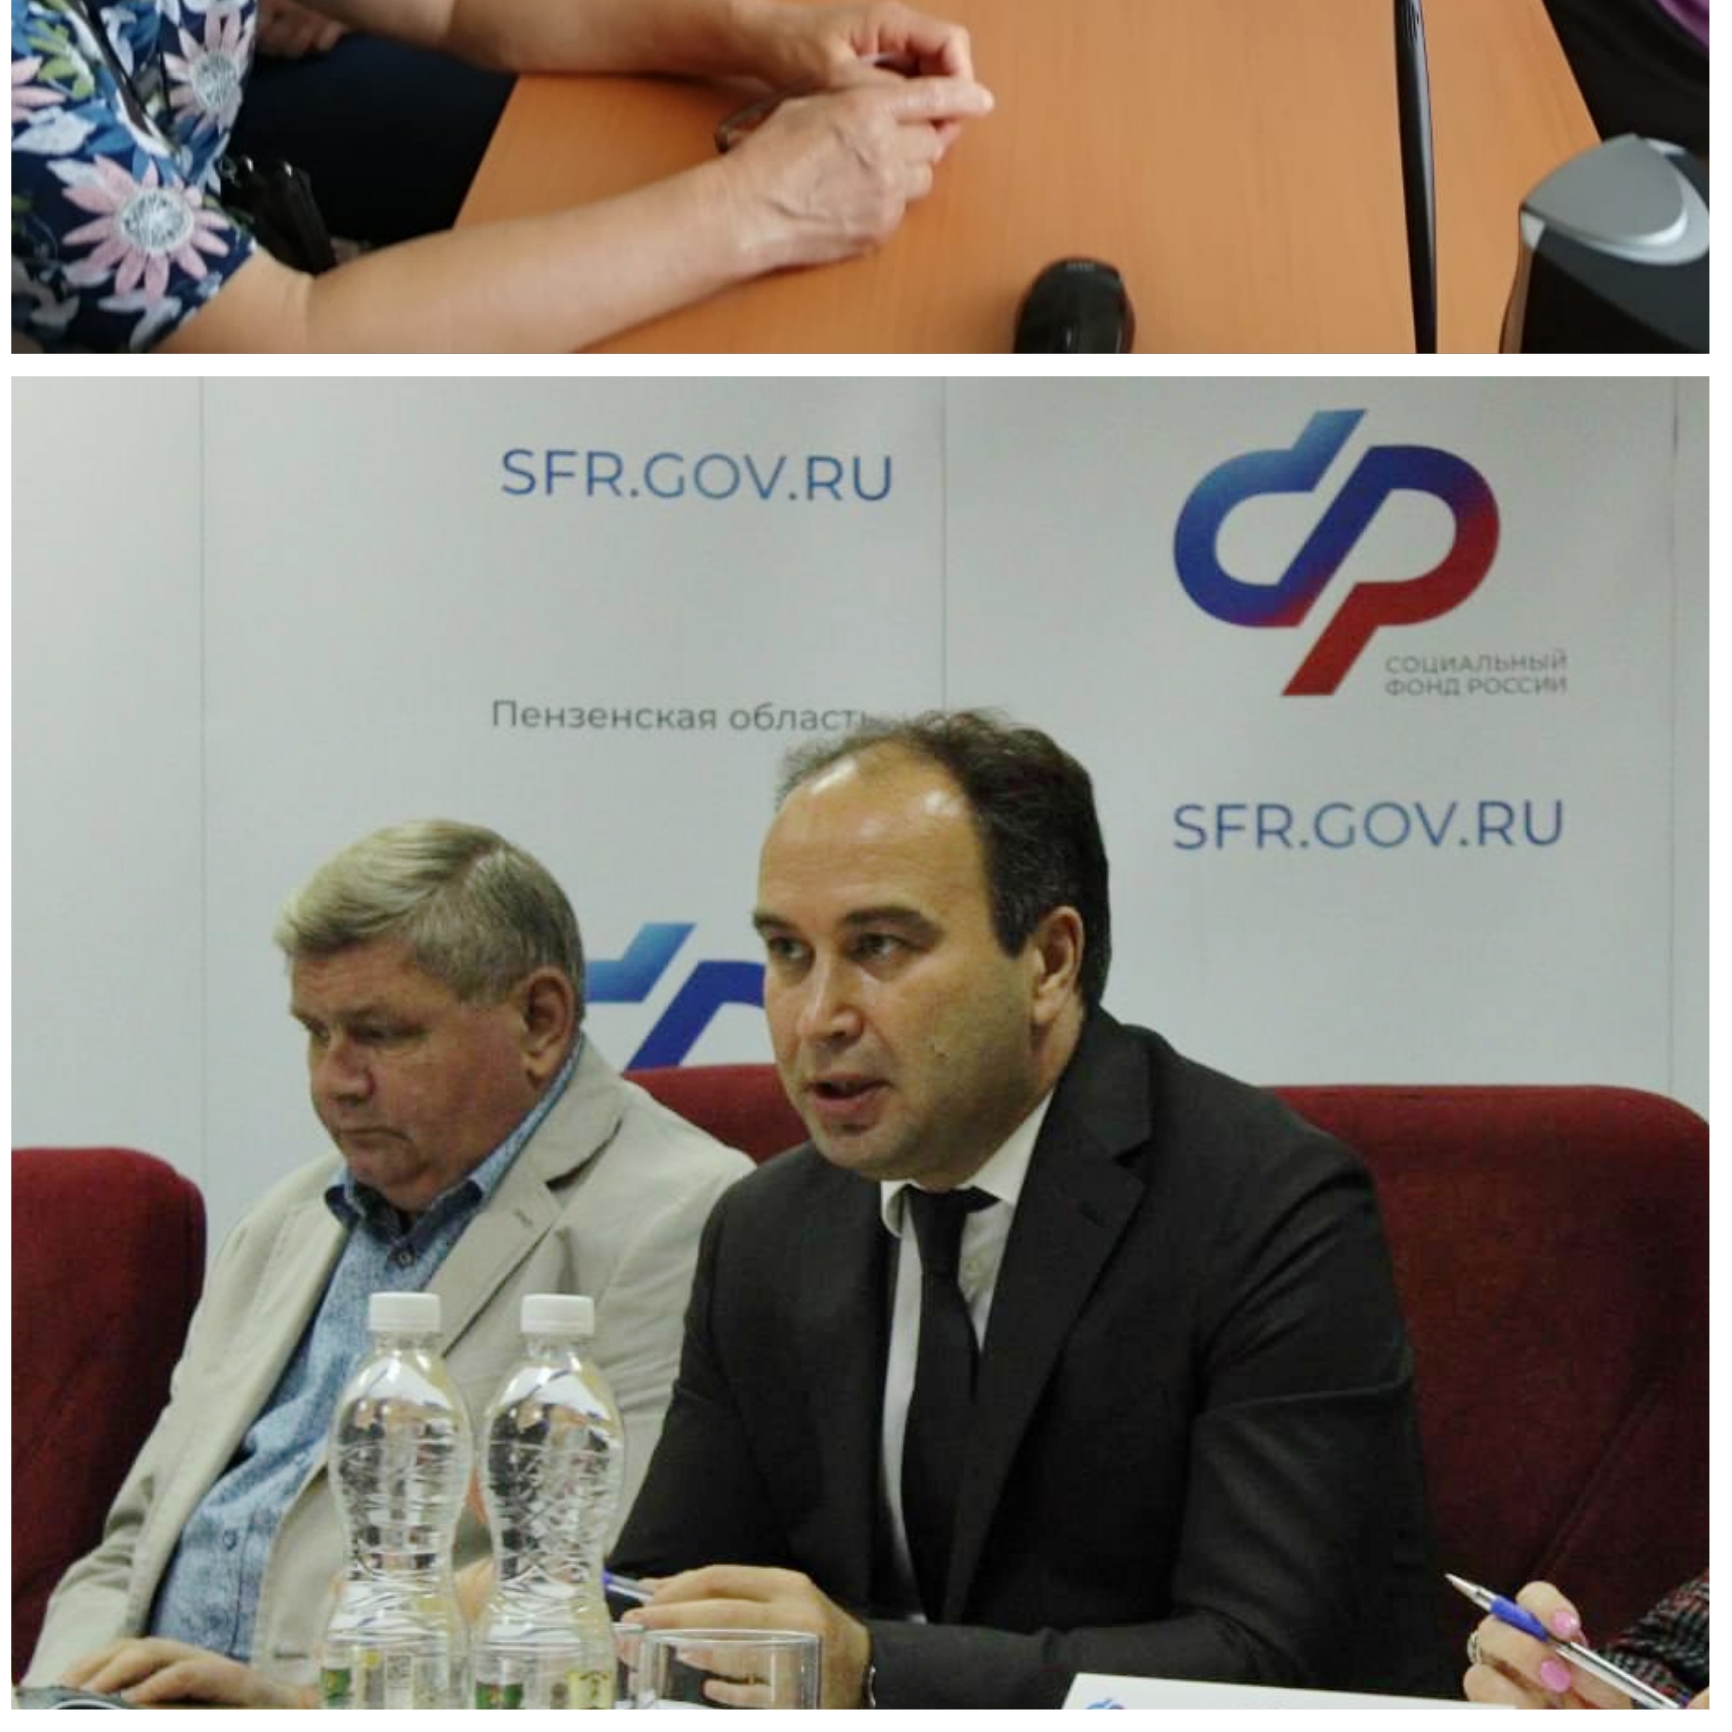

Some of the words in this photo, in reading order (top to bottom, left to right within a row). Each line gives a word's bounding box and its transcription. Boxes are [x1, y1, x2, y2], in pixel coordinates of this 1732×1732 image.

[500, 447, 893, 502] SFR.GOV.RU
[1385, 648, 1566, 676] СОЦИАЛЬНЫЙ
[1385, 676, 1460, 698] ФОНД
[1468, 675, 1566, 695] РОССИИ
[491, 700, 717, 731] Пензенская
[1173, 799, 1564, 851] SFR.GOV.RU
